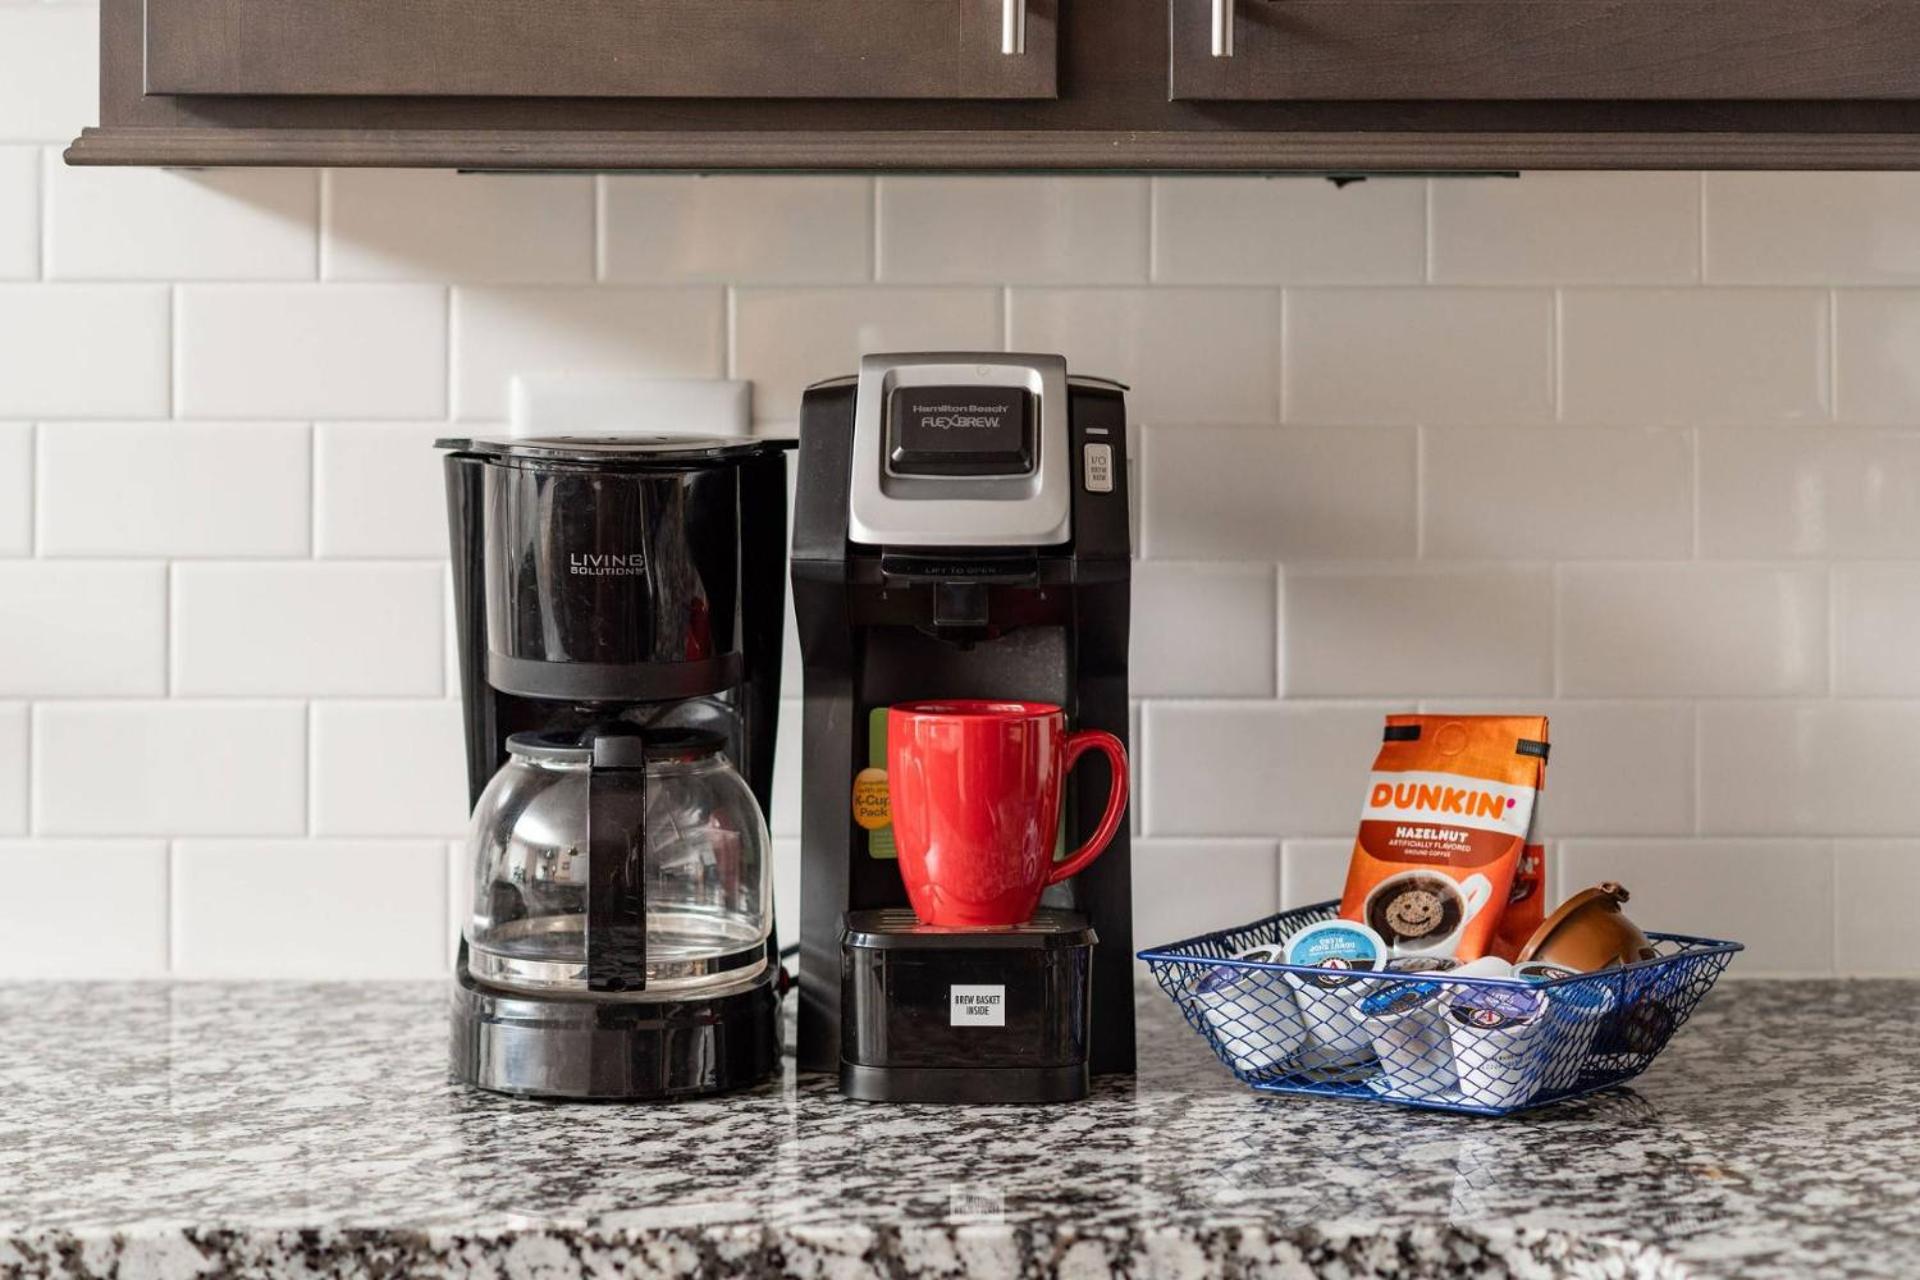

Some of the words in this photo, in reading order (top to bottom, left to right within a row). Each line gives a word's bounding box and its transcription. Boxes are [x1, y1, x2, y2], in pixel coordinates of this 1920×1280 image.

[913, 405, 967, 413] Hamilton
[969, 405, 1006, 413] Beach
[570, 553, 644, 566] LIVING
[570, 566, 645, 576] SOLUTIONS
[860, 808, 888, 817] Pack
[1396, 826, 1469, 843] HAZELNUT
[1388, 838, 1433, 849] ARTIFICIALLY
[1434, 842, 1472, 853] FLAVORED
[955, 995, 975, 1004] BREW
[976, 995, 1000, 1004] BASKET
[966, 1006, 990, 1015] INSIDE
